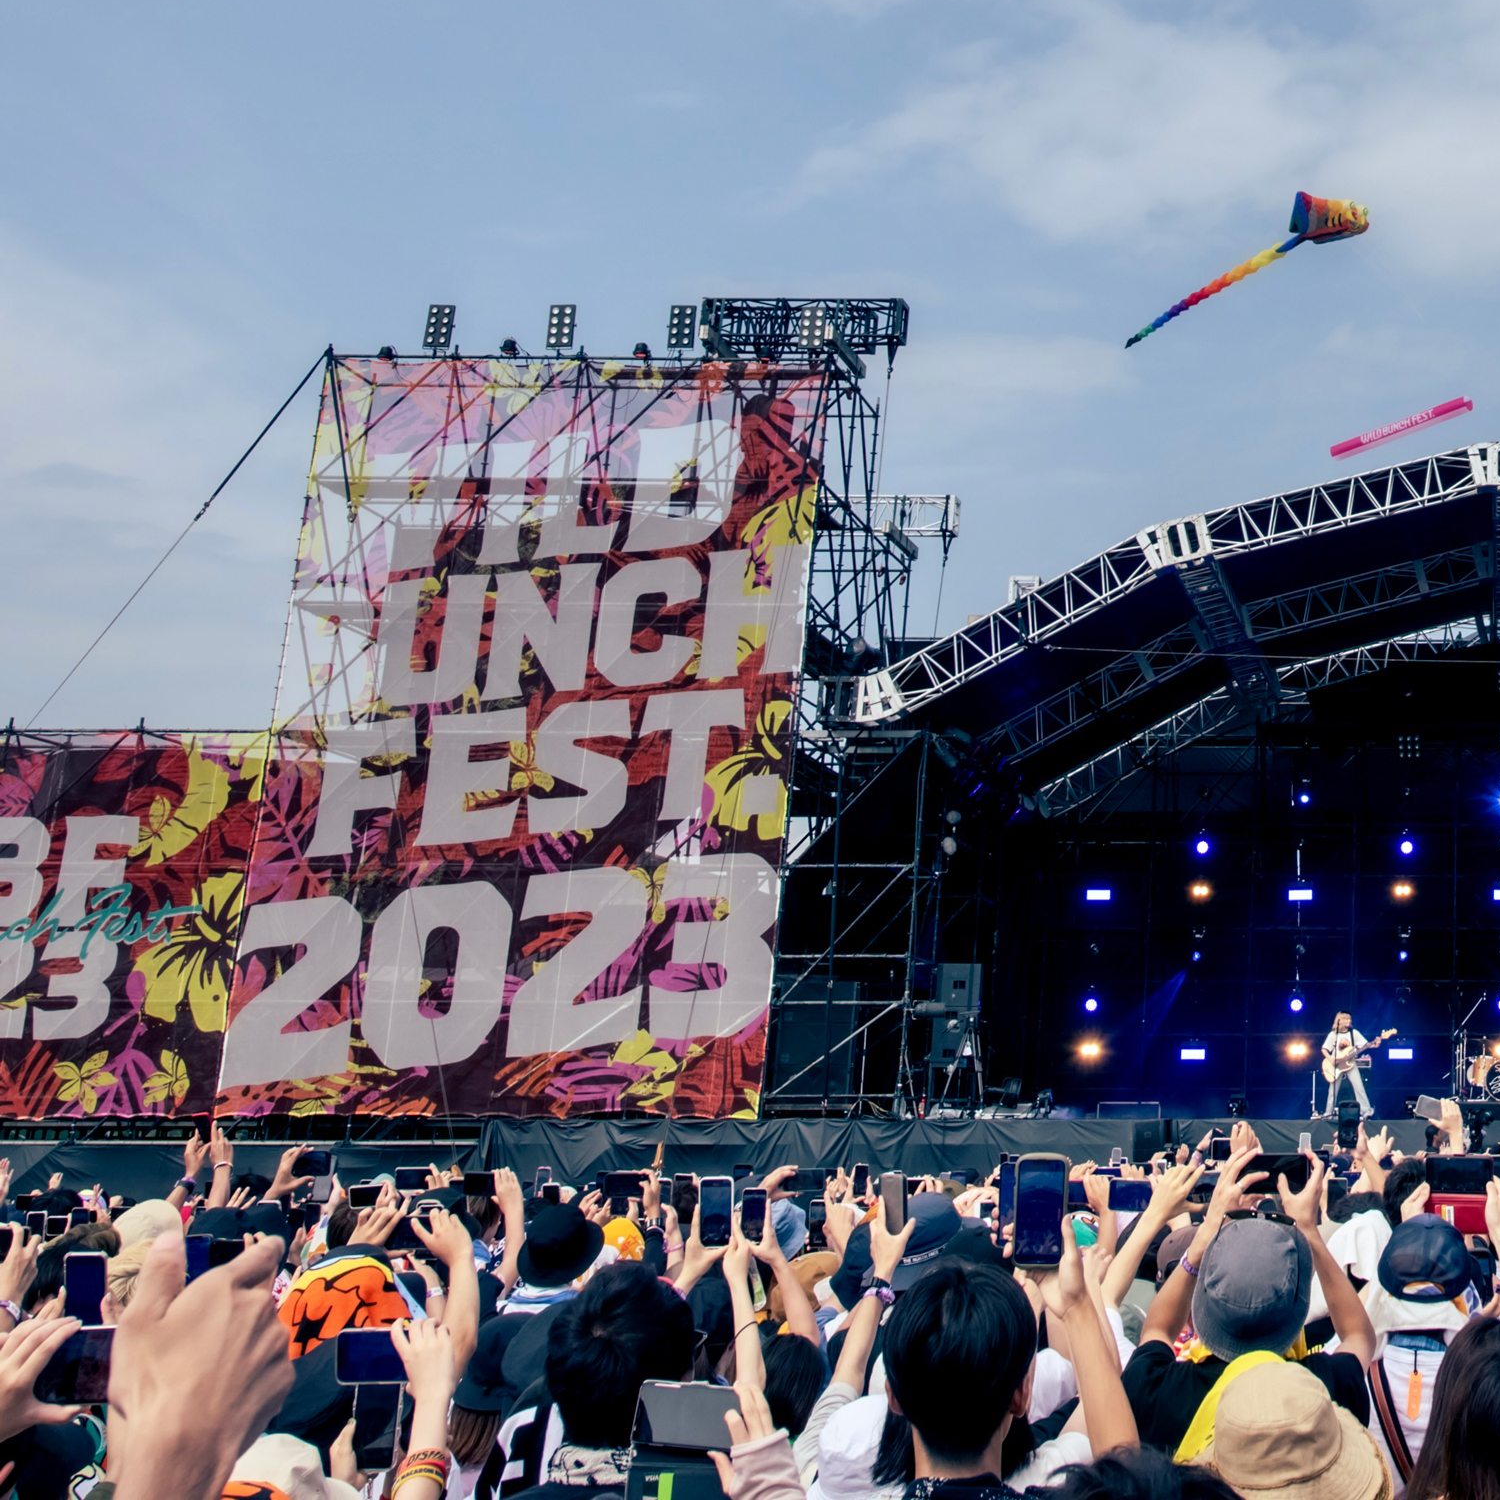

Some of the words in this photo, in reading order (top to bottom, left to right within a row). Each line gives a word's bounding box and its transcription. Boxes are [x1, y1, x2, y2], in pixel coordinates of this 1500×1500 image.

[1360, 426, 1382, 444] WILD
[1382, 417, 1411, 437] BUNCH
[306, 689, 782, 857] FEST.
[75, 882, 203, 961] Fest.
[217, 852, 778, 1091] 2023
